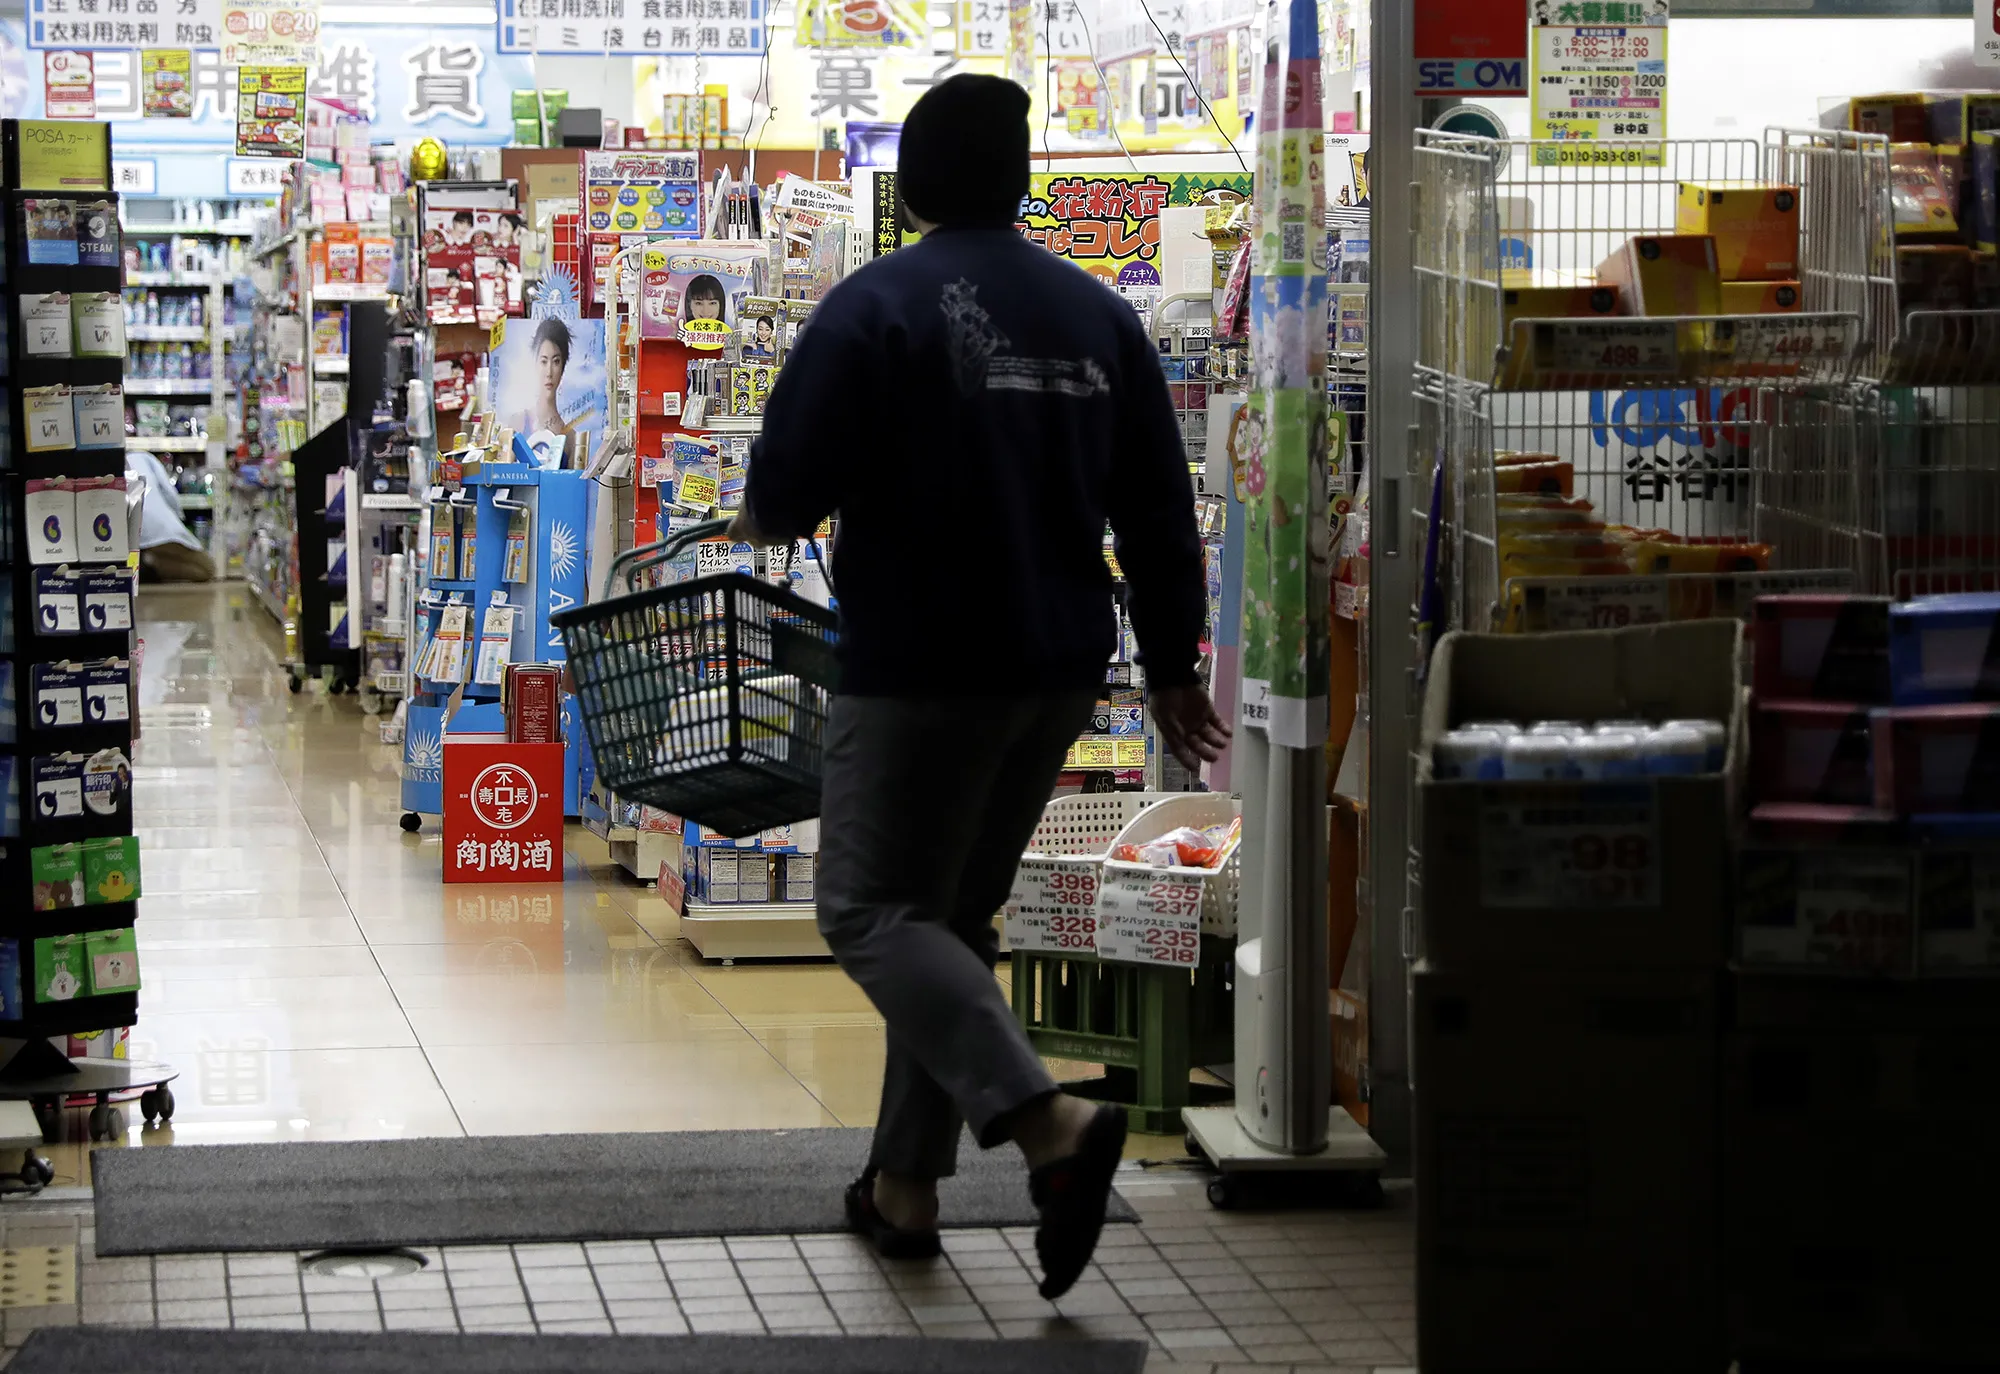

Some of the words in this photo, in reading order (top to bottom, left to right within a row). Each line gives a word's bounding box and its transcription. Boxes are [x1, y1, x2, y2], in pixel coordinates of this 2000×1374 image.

[48, 22, 158, 43] 衣料用洗剤
[643, 27, 748, 48] 台所用品
[1419, 60, 1521, 88] SECOM
[26, 128, 64, 143] POSA
[67, 133, 94, 143] カード
[1613, 123, 1649, 135] 谷中店
[1050, 177, 1169, 219] 花粉症
[80, 242, 113, 253] STEAM
[1124, 269, 1154, 279] フェキソ
[698, 485, 714, 496] 398
[699, 542, 730, 558] 花粉
[699, 557, 730, 567] ウイルス
[514, 786, 529, 805] 長
[456, 839, 552, 872] 陶陶酒
[1049, 872, 1096, 892] 398
[1121, 870, 1176, 882] オンパックス
[1057, 890, 1094, 906] 369
[1149, 883, 1201, 901] 255
[1154, 901, 1197, 916] 237
[1050, 915, 1097, 933] 328
[1115, 915, 1175, 928] オンパックスミニ
[1058, 933, 1095, 949] 304
[1145, 928, 1198, 947] 235
[1154, 946, 1195, 963] 218
